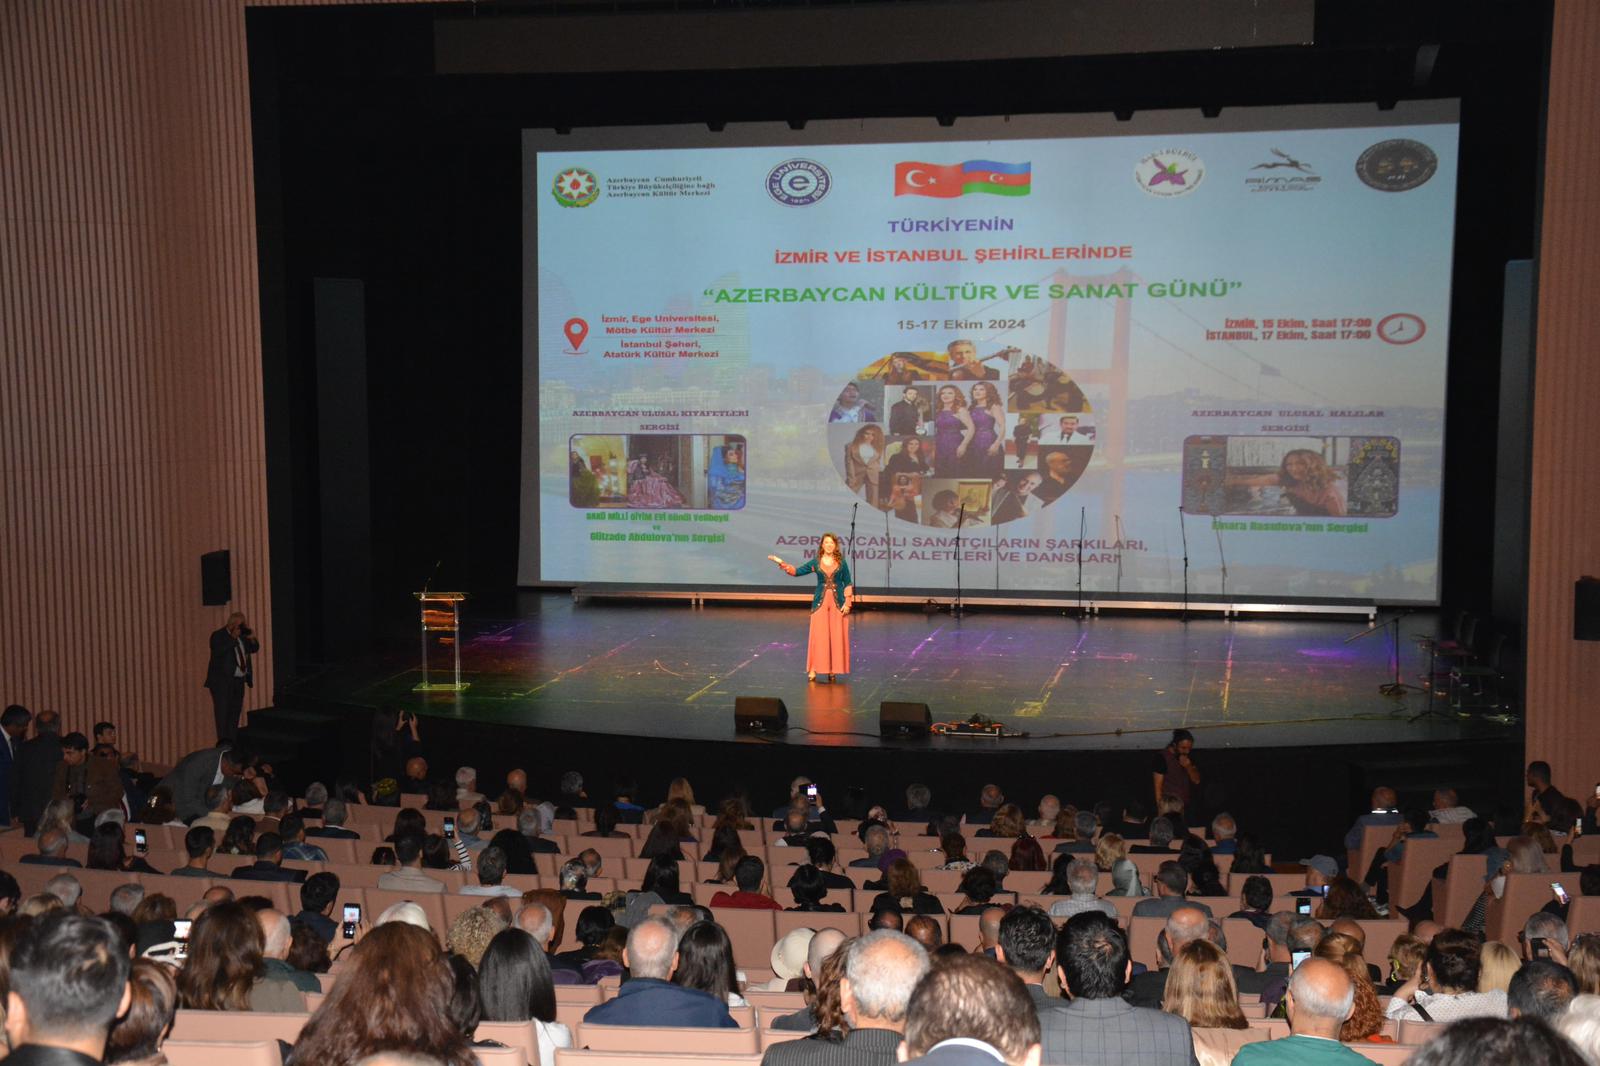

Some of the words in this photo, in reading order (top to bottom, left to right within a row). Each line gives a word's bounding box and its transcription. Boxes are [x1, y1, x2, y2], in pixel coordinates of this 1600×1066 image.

[888, 217, 1014, 233] TÜRKİYENİN
[774, 248, 829, 264] İZMİR
[835, 251, 861, 263] VE
[866, 248, 968, 263] İSTANBUL
[974, 244, 1133, 264] ŞEHİRLERİNDE
[894, 282, 998, 301] KÜLTÜR
[1005, 284, 1040, 300] VE
[1048, 282, 1139, 299] SANAT
[601, 314, 629, 323] İzmir,
[632, 315, 652, 324] Ege
[897, 320, 938, 330] 15-17
[944, 319, 983, 330] Ekim
[988, 319, 1026, 329] 2024
[1262, 319, 1274, 328] 15
[1277, 318, 1308, 329] Ekim,
[1311, 318, 1337, 328] Saat
[1341, 318, 1372, 328] 17:00
[640, 326, 673, 334] Kültür
[675, 325, 715, 333] Merkezi
[1206, 330, 1258, 341] İSTANBUL,
[1261, 331, 1273, 340] 17
[1276, 330, 1308, 341] Ekim,
[1311, 330, 1337, 340] Saat
[1341, 330, 1372, 339] 17:00
[620, 340, 662, 348] İstanbul
[603, 350, 641, 358] Atatürk
[643, 350, 676, 358] Kültür
[678, 350, 719, 358] Merkezi
[681, 409, 749, 417] KIYAFETLERİ
[1191, 409, 1272, 417] AZERBAYCAN
[1279, 409, 1324, 417] ULUSAL
[639, 423, 680, 431] SERGİSİ
[776, 535, 906, 547] AZƏRAYCANLI
[911, 536, 1041, 551] SANATÇILARIN
[1046, 538, 1148, 551] ŞARKILARI,
[998, 551, 1021, 562] VE
